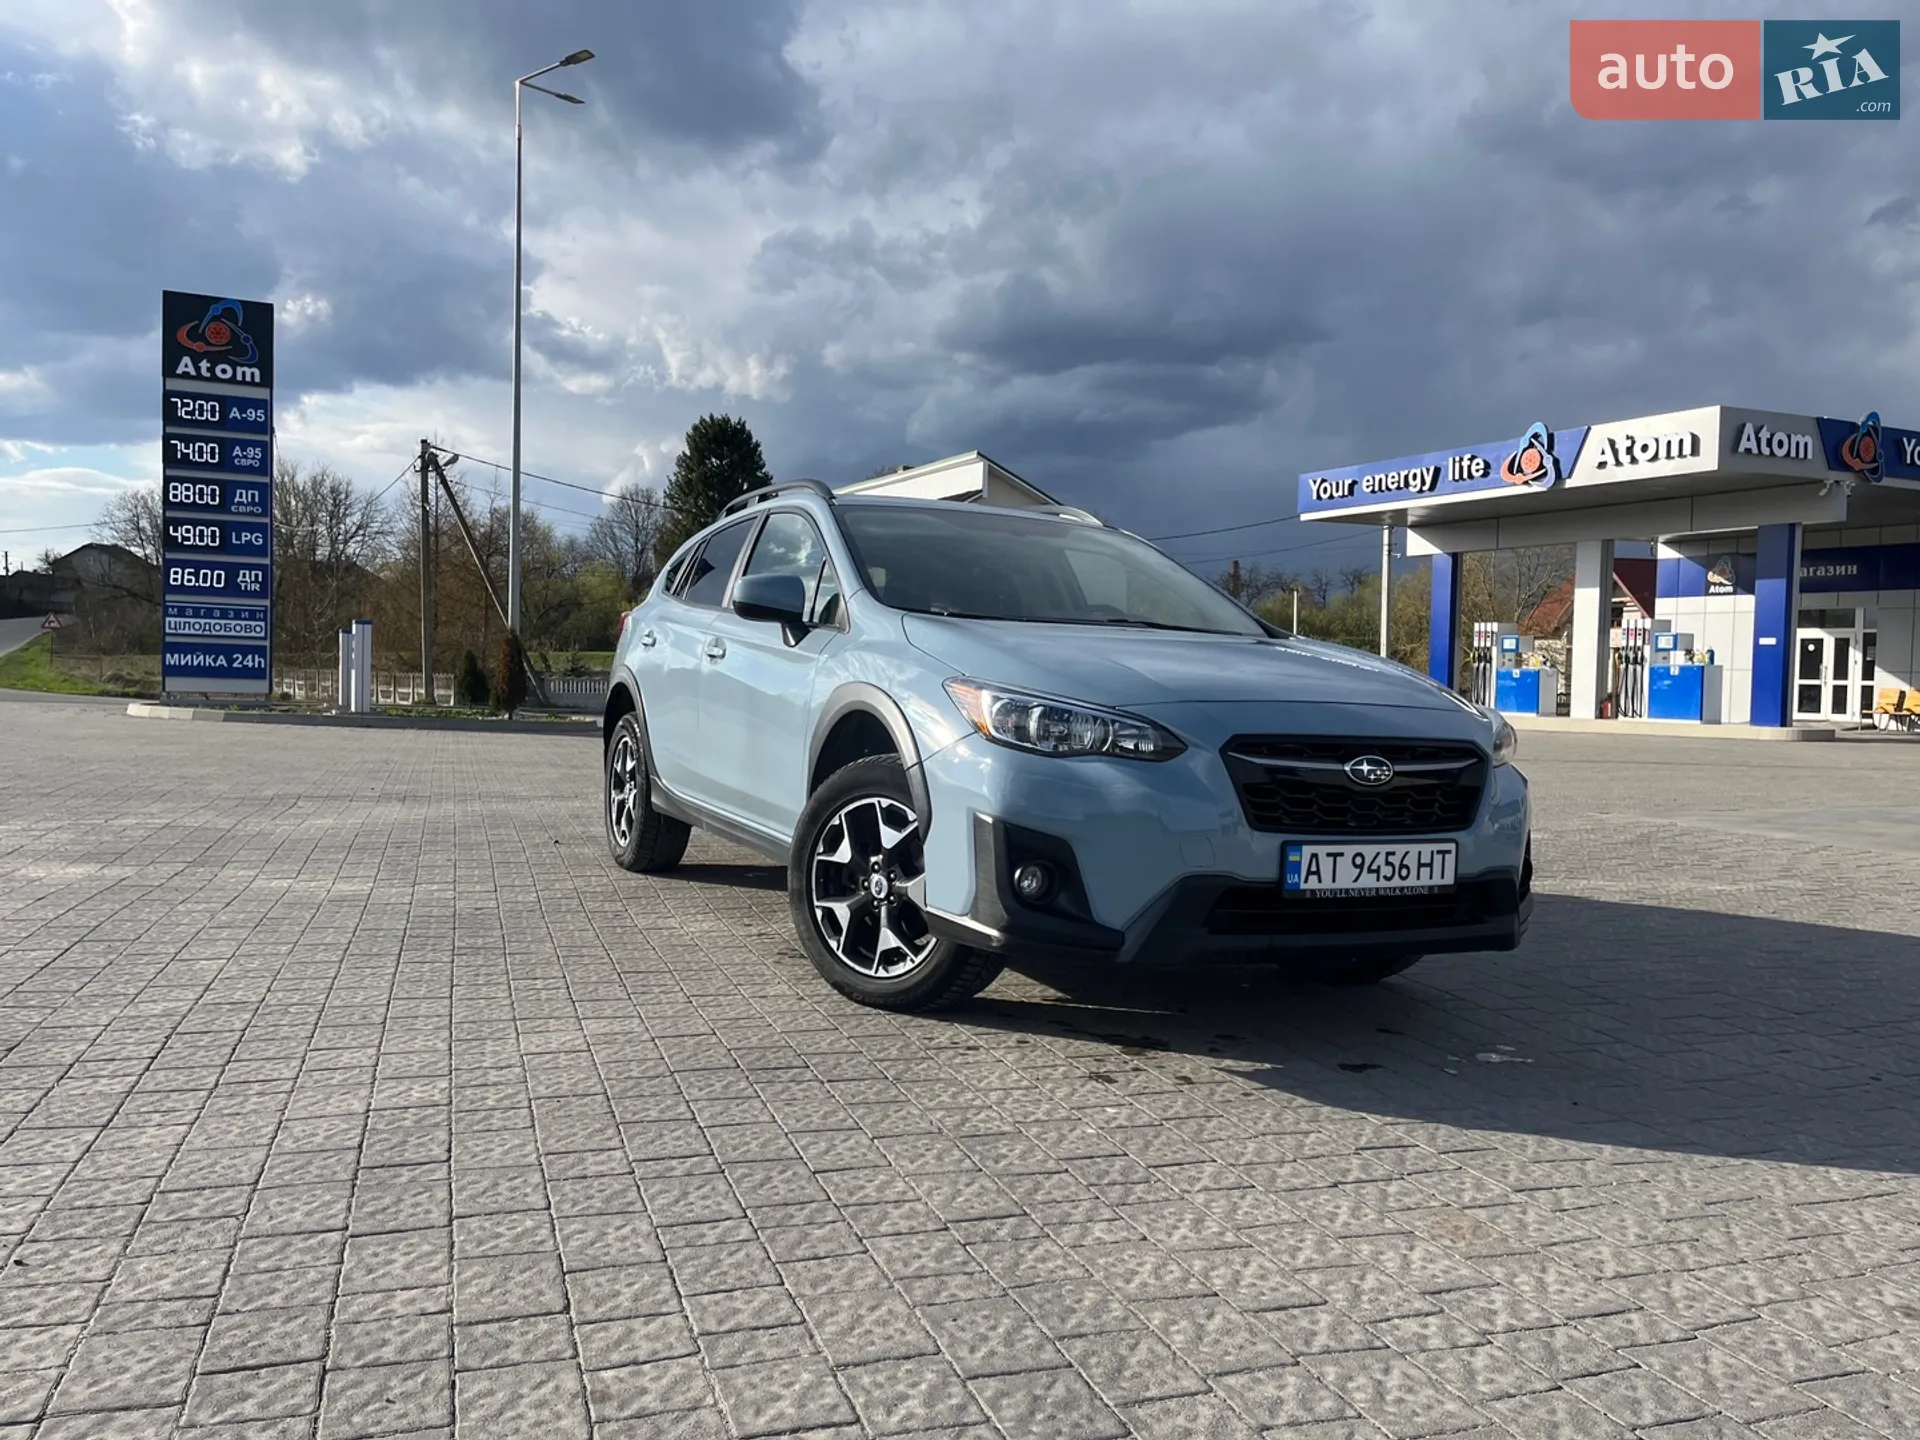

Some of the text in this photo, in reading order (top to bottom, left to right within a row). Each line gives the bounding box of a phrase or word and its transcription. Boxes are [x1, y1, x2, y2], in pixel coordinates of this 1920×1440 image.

[175, 356, 260, 383] Atom
[170, 398, 219, 421] 72.00
[1597, 431, 1694, 469] Atom
[1738, 422, 1813, 460] Atom
[170, 440, 219, 463] 74.00
[1308, 454, 1486, 500] Your energy life
[234, 489, 259, 504] ДП
[231, 505, 262, 513] ЄВРО
[169, 525, 263, 546] 49.00 LPG
[169, 568, 262, 588] 86.00 ДП
[1799, 564, 1858, 578] агазин
[240, 582, 260, 591] TIR
[1708, 585, 1734, 594] Atom
[167, 620, 264, 635] ЦІЛОДОБОВО
[166, 651, 265, 669] МИЙКА 24h
[1304, 850, 1452, 884] AT 9456 HT
[1287, 872, 1300, 884] UA
[1348, 887, 1376, 897] NEVER
[1378, 886, 1401, 896] WALK
[1402, 886, 1429, 895] ALONE
